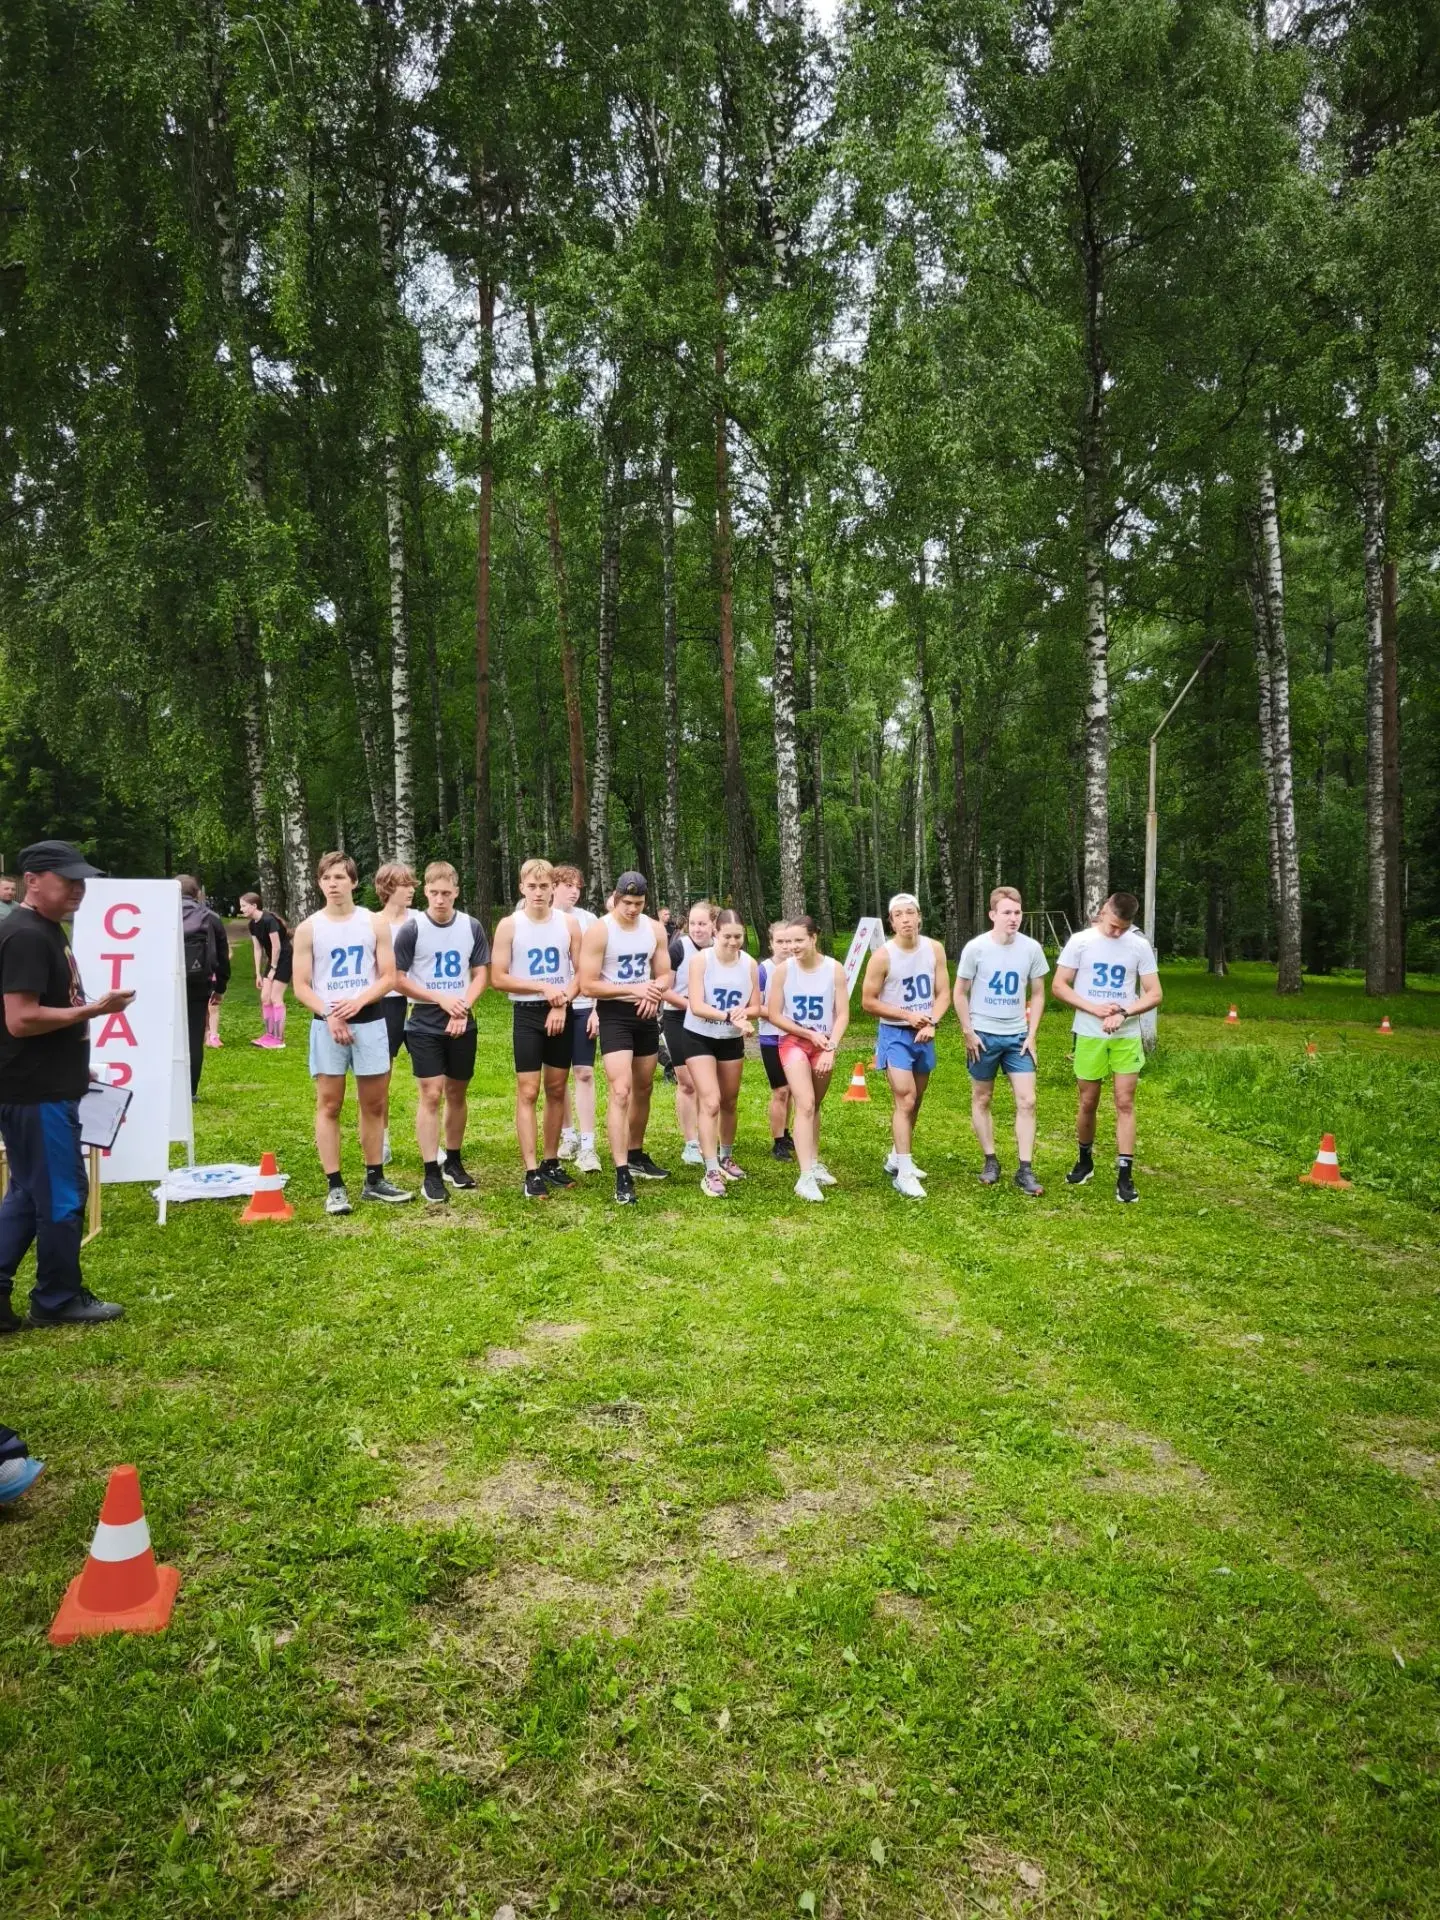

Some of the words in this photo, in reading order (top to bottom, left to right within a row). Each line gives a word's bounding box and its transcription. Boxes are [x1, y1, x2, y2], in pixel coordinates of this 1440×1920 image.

[330, 945, 364, 978] 27
[433, 949, 462, 978] 18
[527, 946, 560, 976] 29
[617, 952, 649, 980] 33
[902, 973, 932, 1002] 30
[988, 970, 1020, 996] 40
[1092, 962, 1127, 988] 39
[712, 987, 743, 1012] 36
[1087, 988, 1127, 1000] КОСТРОМА
[792, 995, 824, 1021] 35
